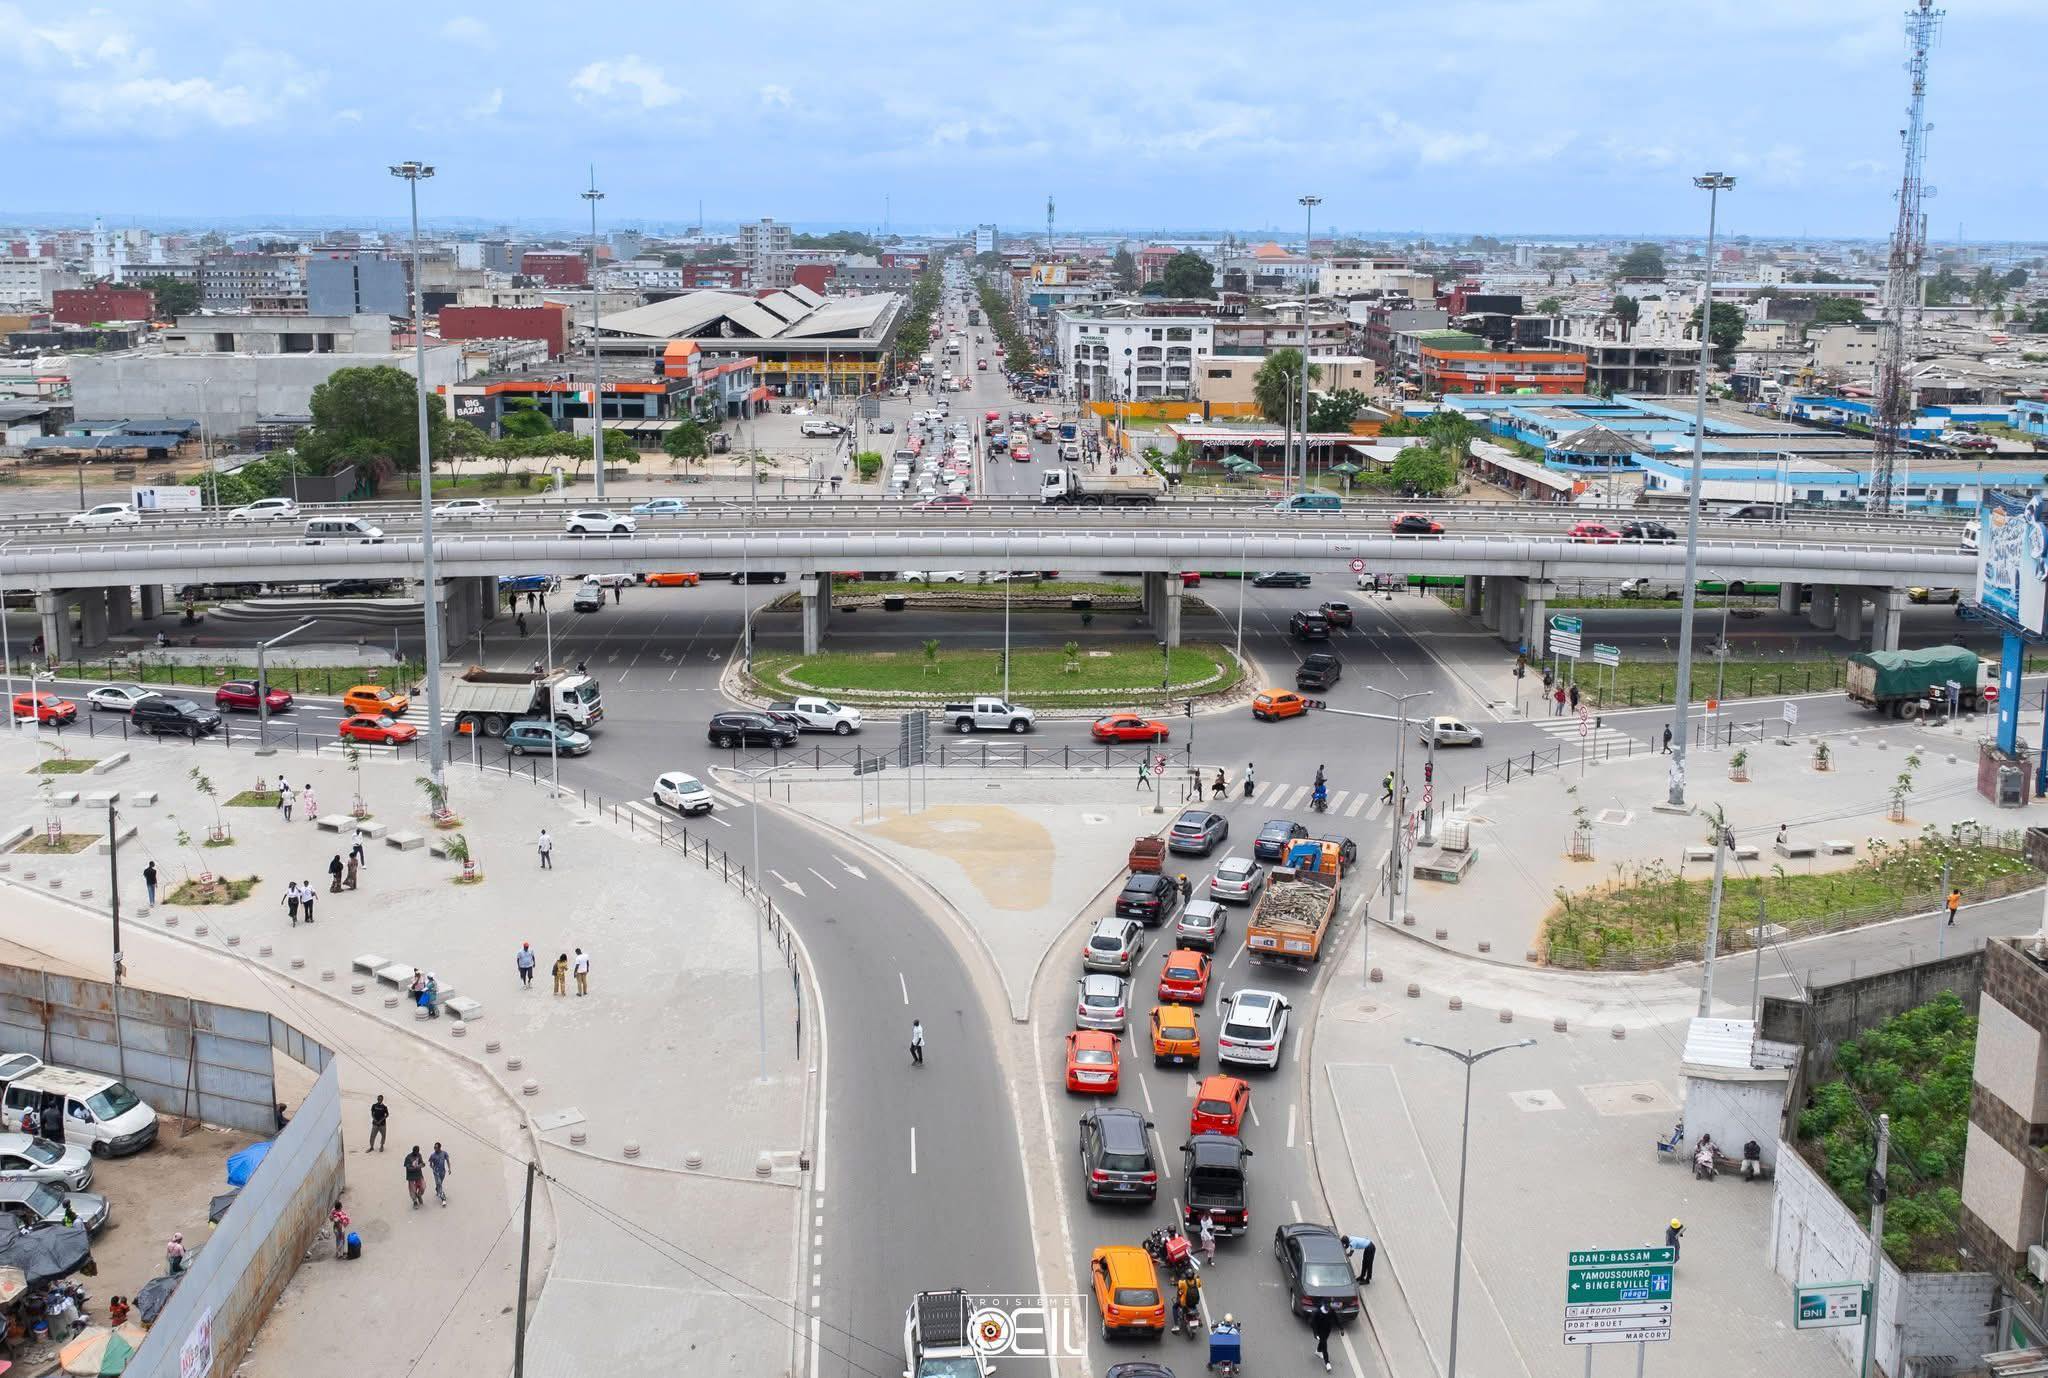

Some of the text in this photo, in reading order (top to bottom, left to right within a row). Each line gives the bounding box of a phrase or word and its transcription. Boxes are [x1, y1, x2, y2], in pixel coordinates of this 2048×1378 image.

[464, 399, 480, 408] BIG
[456, 406, 486, 416] BAZAR
[1572, 1252, 1650, 1263] GRAND-BASSAM
[1580, 1270, 1650, 1280] YAMOUSSOUKRO
[1585, 1279, 1649, 1290] BINGERVILLE
[1803, 1309, 1823, 1318] BNI
[1567, 1320, 1623, 1329] PORT-BOUET
[1625, 1332, 1667, 1340] MARCORY
